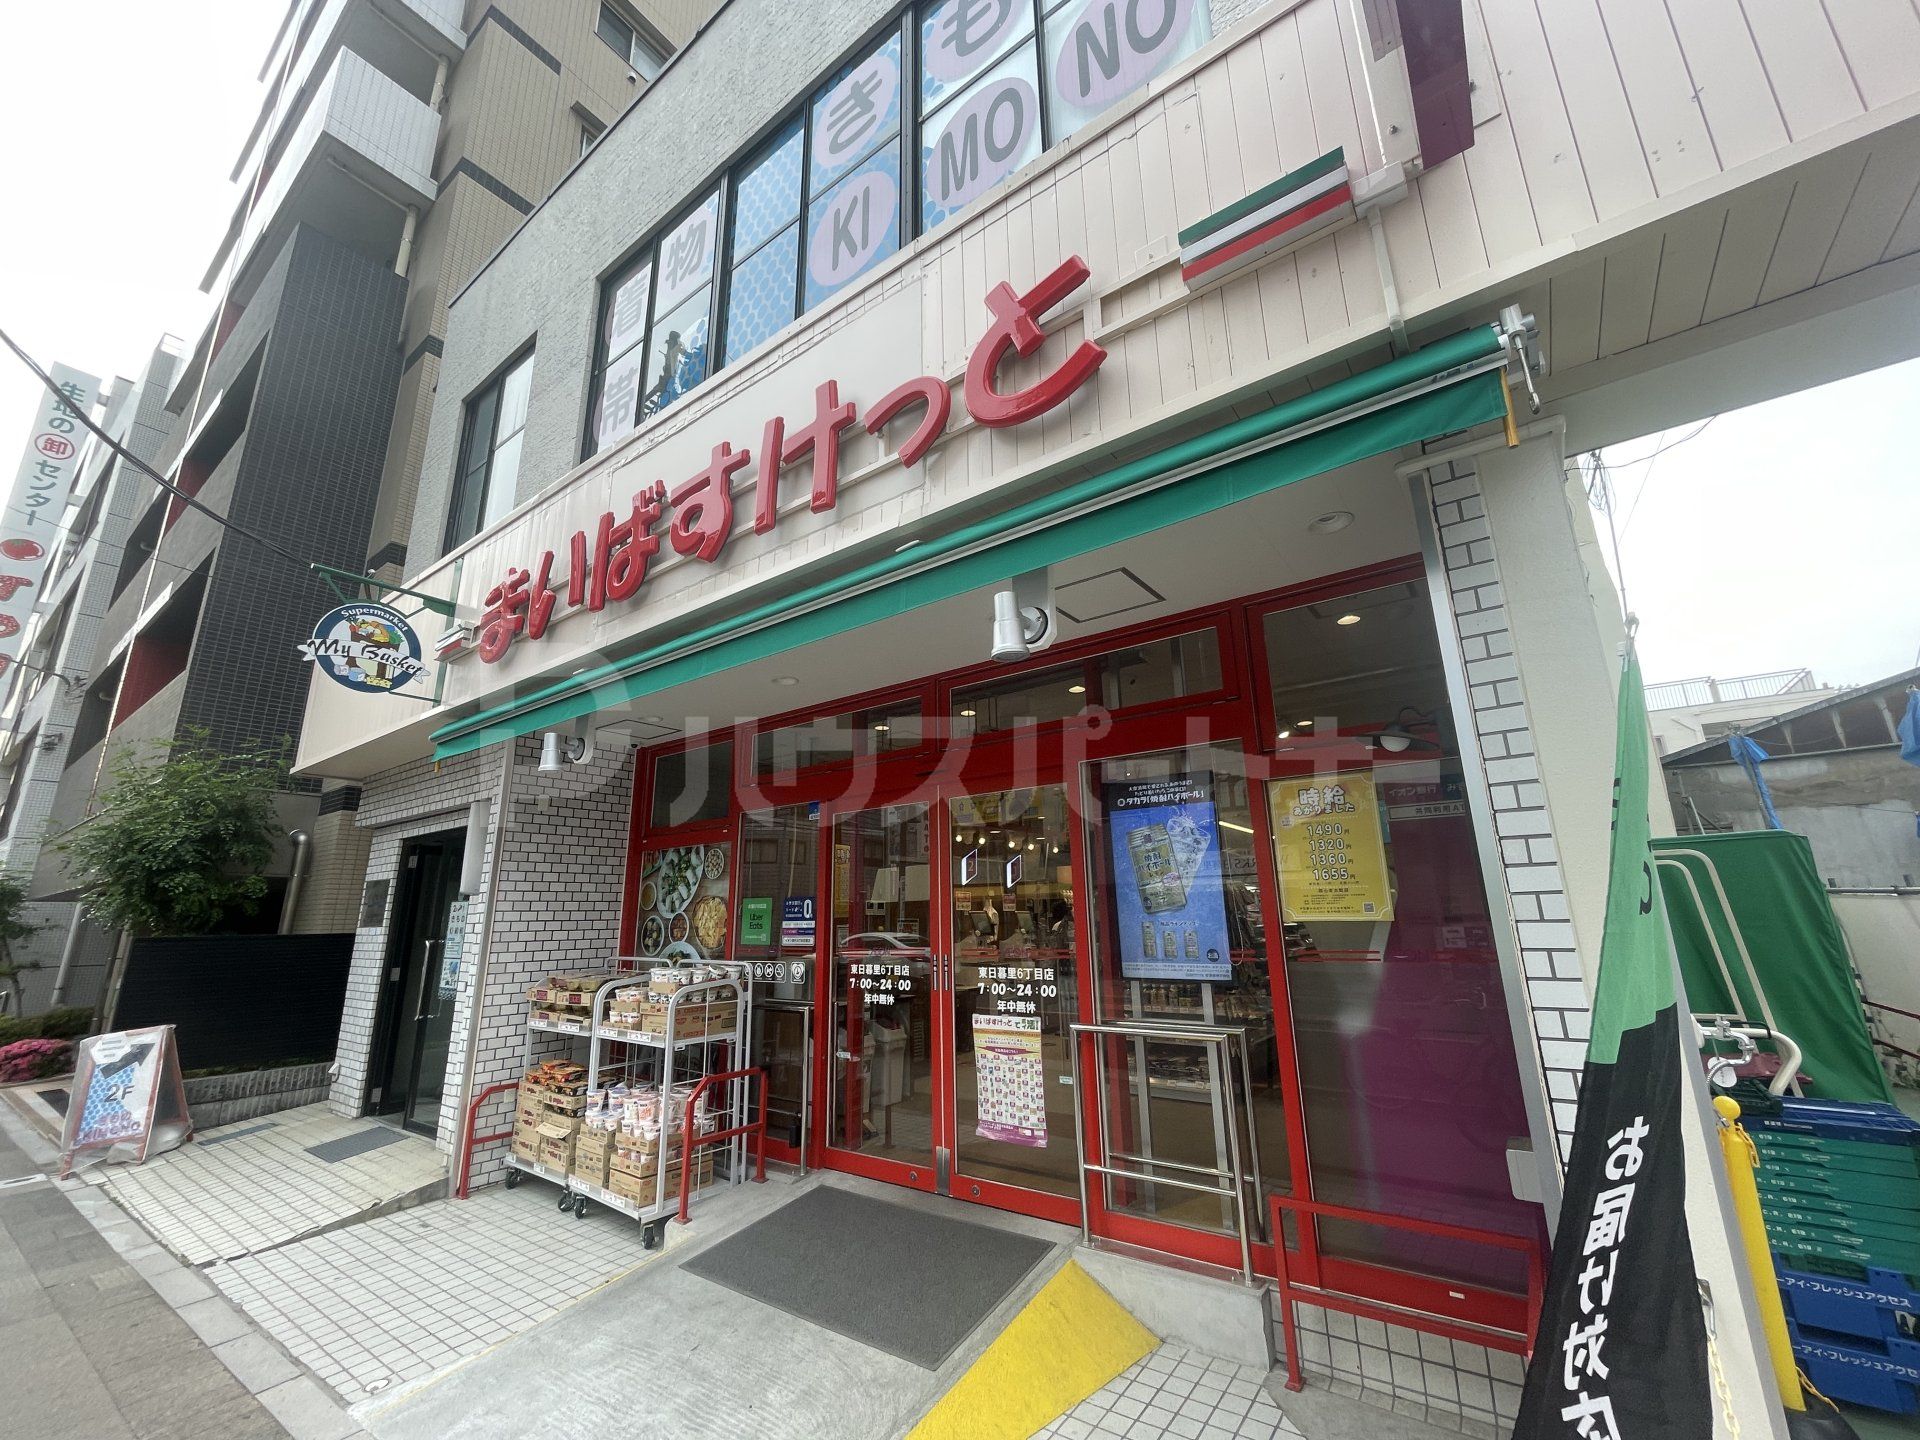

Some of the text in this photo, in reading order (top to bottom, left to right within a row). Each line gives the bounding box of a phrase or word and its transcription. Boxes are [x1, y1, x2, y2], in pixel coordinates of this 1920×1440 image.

[479, 254, 1107, 664] まいばすけっと
[341, 607, 408, 632] Supermarket
[307, 639, 424, 677] My Basket
[1298, 785, 1345, 806] 時給
[1293, 802, 1355, 816] あがりました
[850, 964, 910, 977] 東日暮里6丁目店
[978, 967, 1054, 981] 東日暮里6丁目店
[864, 993, 895, 1006] 年中無休
[997, 1000, 1037, 1014] 年中無休
[104, 1083, 135, 1103] 2F
